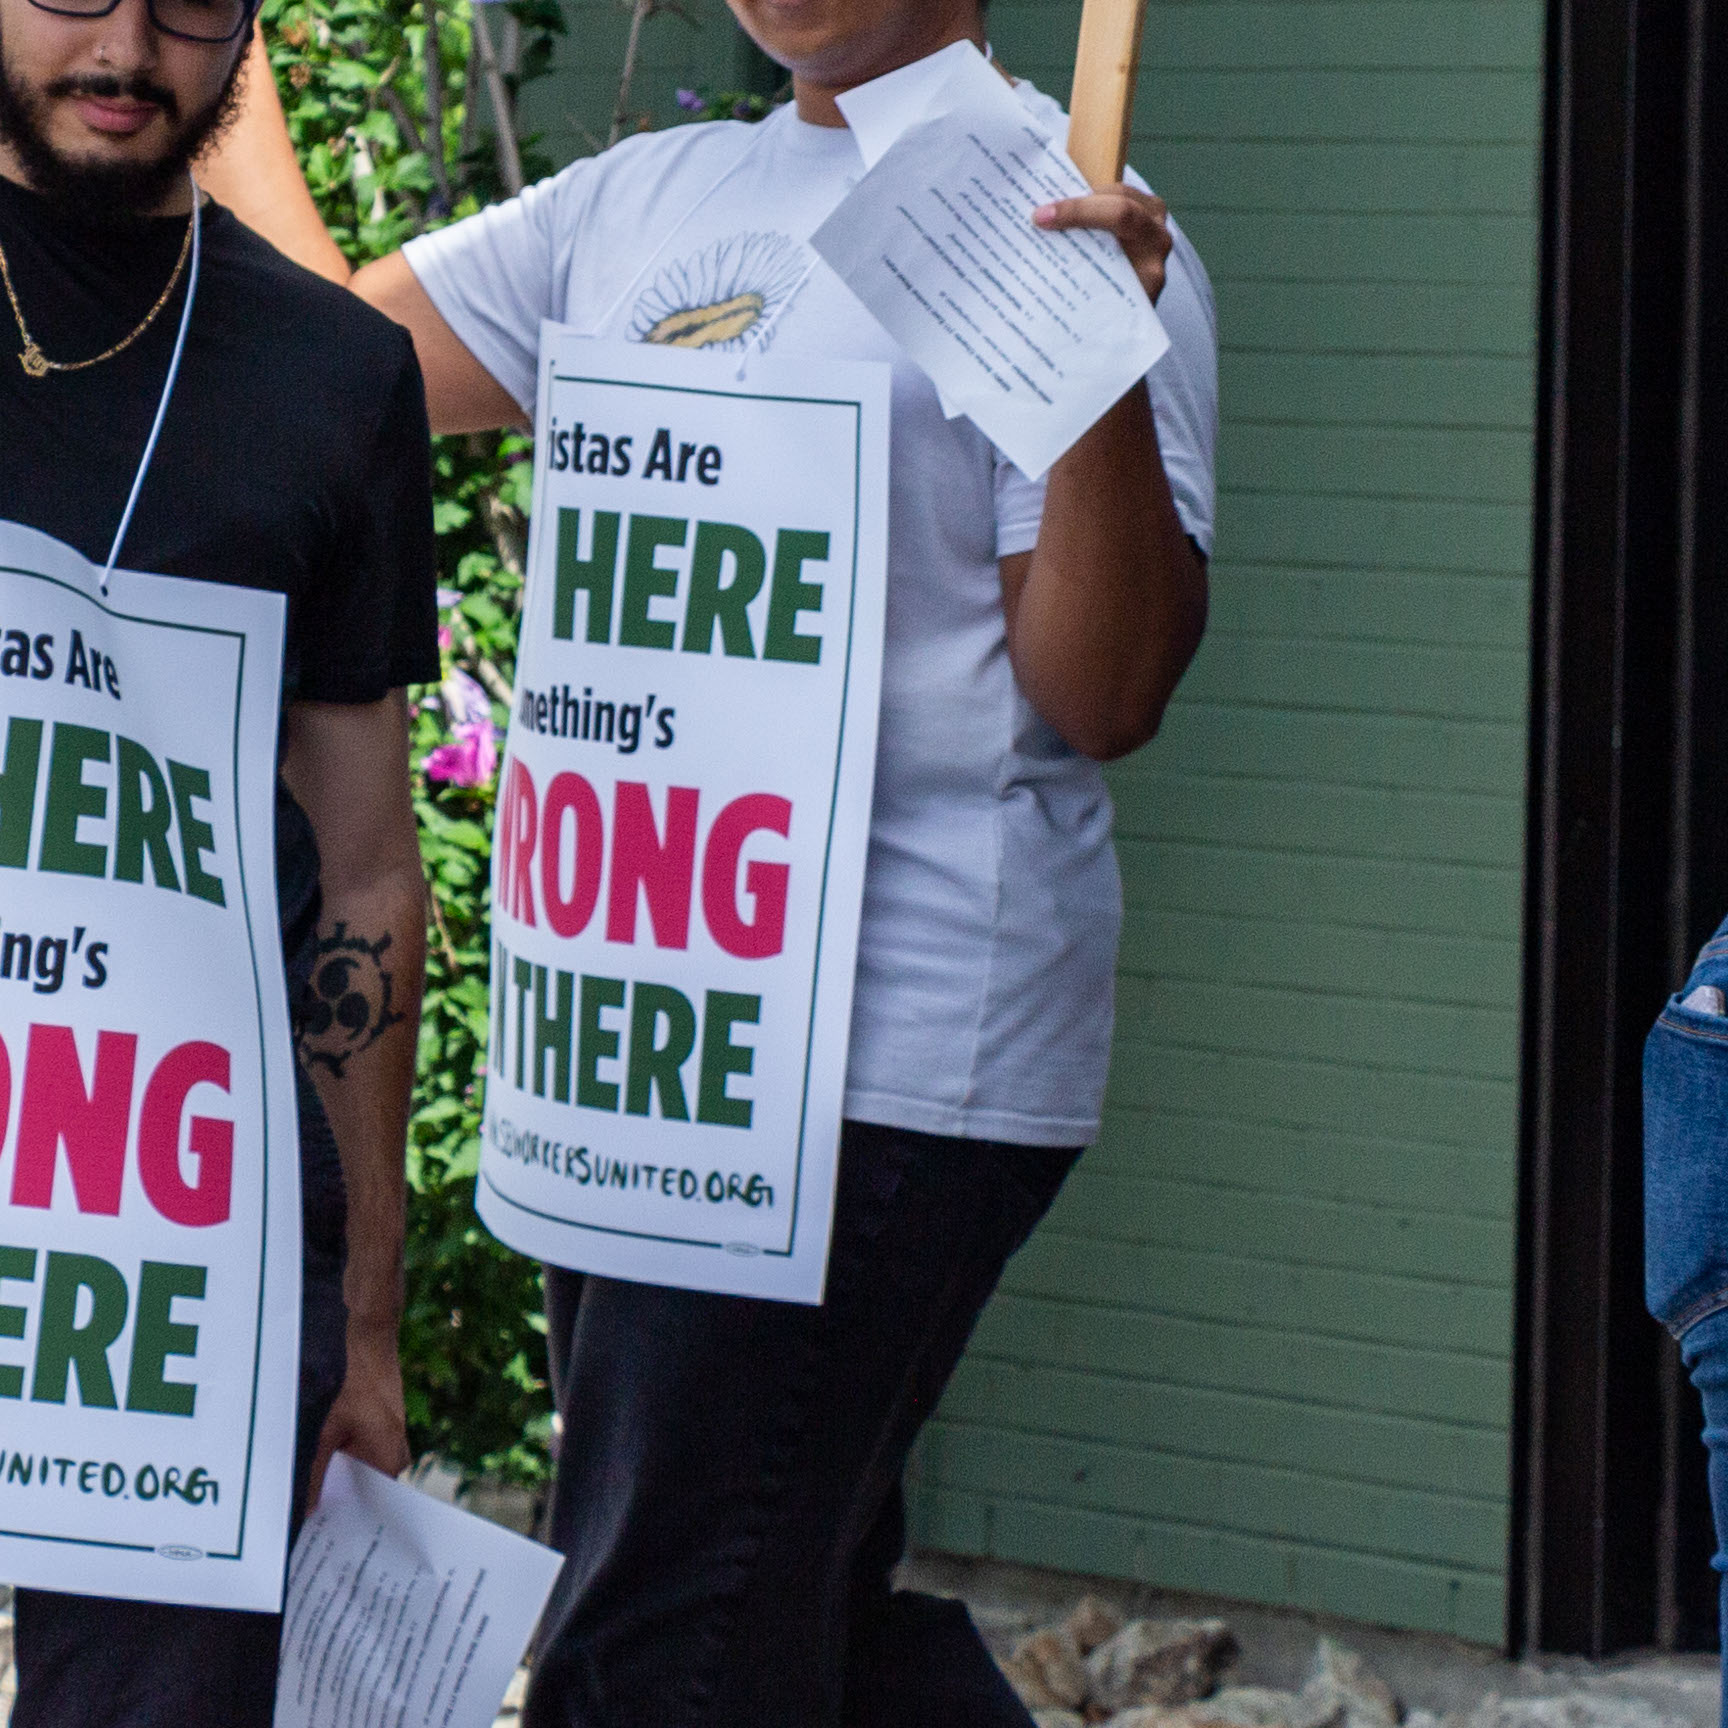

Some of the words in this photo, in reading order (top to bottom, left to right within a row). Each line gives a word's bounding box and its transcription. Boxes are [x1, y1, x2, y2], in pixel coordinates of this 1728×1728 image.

[641, 428, 722, 486] Are
[553, 506, 830, 666] HERE
[64, 628, 121, 701] Are
[514, 955, 762, 1130] THERE
